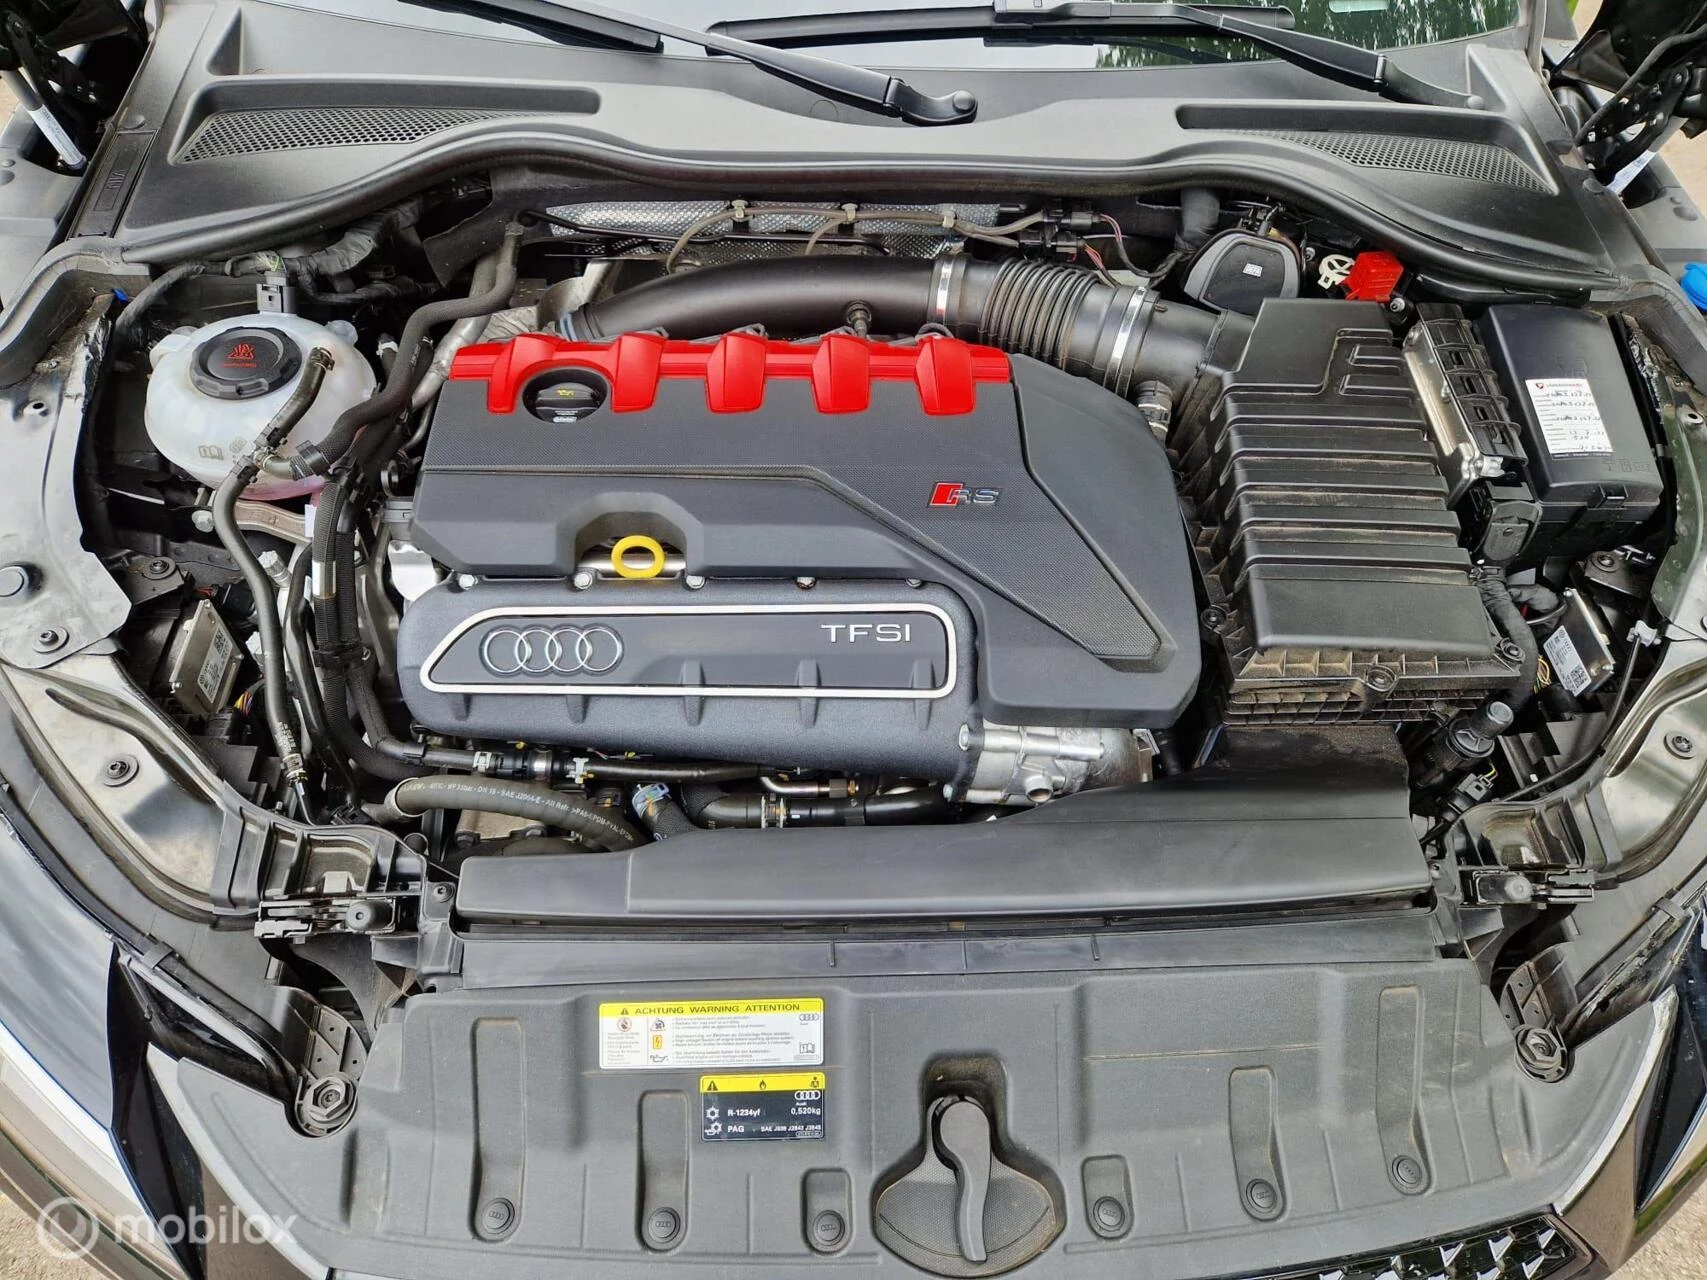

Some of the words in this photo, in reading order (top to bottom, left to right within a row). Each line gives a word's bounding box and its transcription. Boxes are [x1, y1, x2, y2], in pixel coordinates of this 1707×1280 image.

[936, 484, 999, 505] RS
[820, 623, 911, 643] TFSI
[634, 1006, 685, 1015] ACHTUNG
[689, 1005, 740, 1013] WARNING
[745, 1003, 800, 1012] ATTENTION
[727, 1108, 761, 1118] R-1234yf
[790, 1106, 821, 1116] 0,520kg
[727, 1125, 745, 1133] PAG
